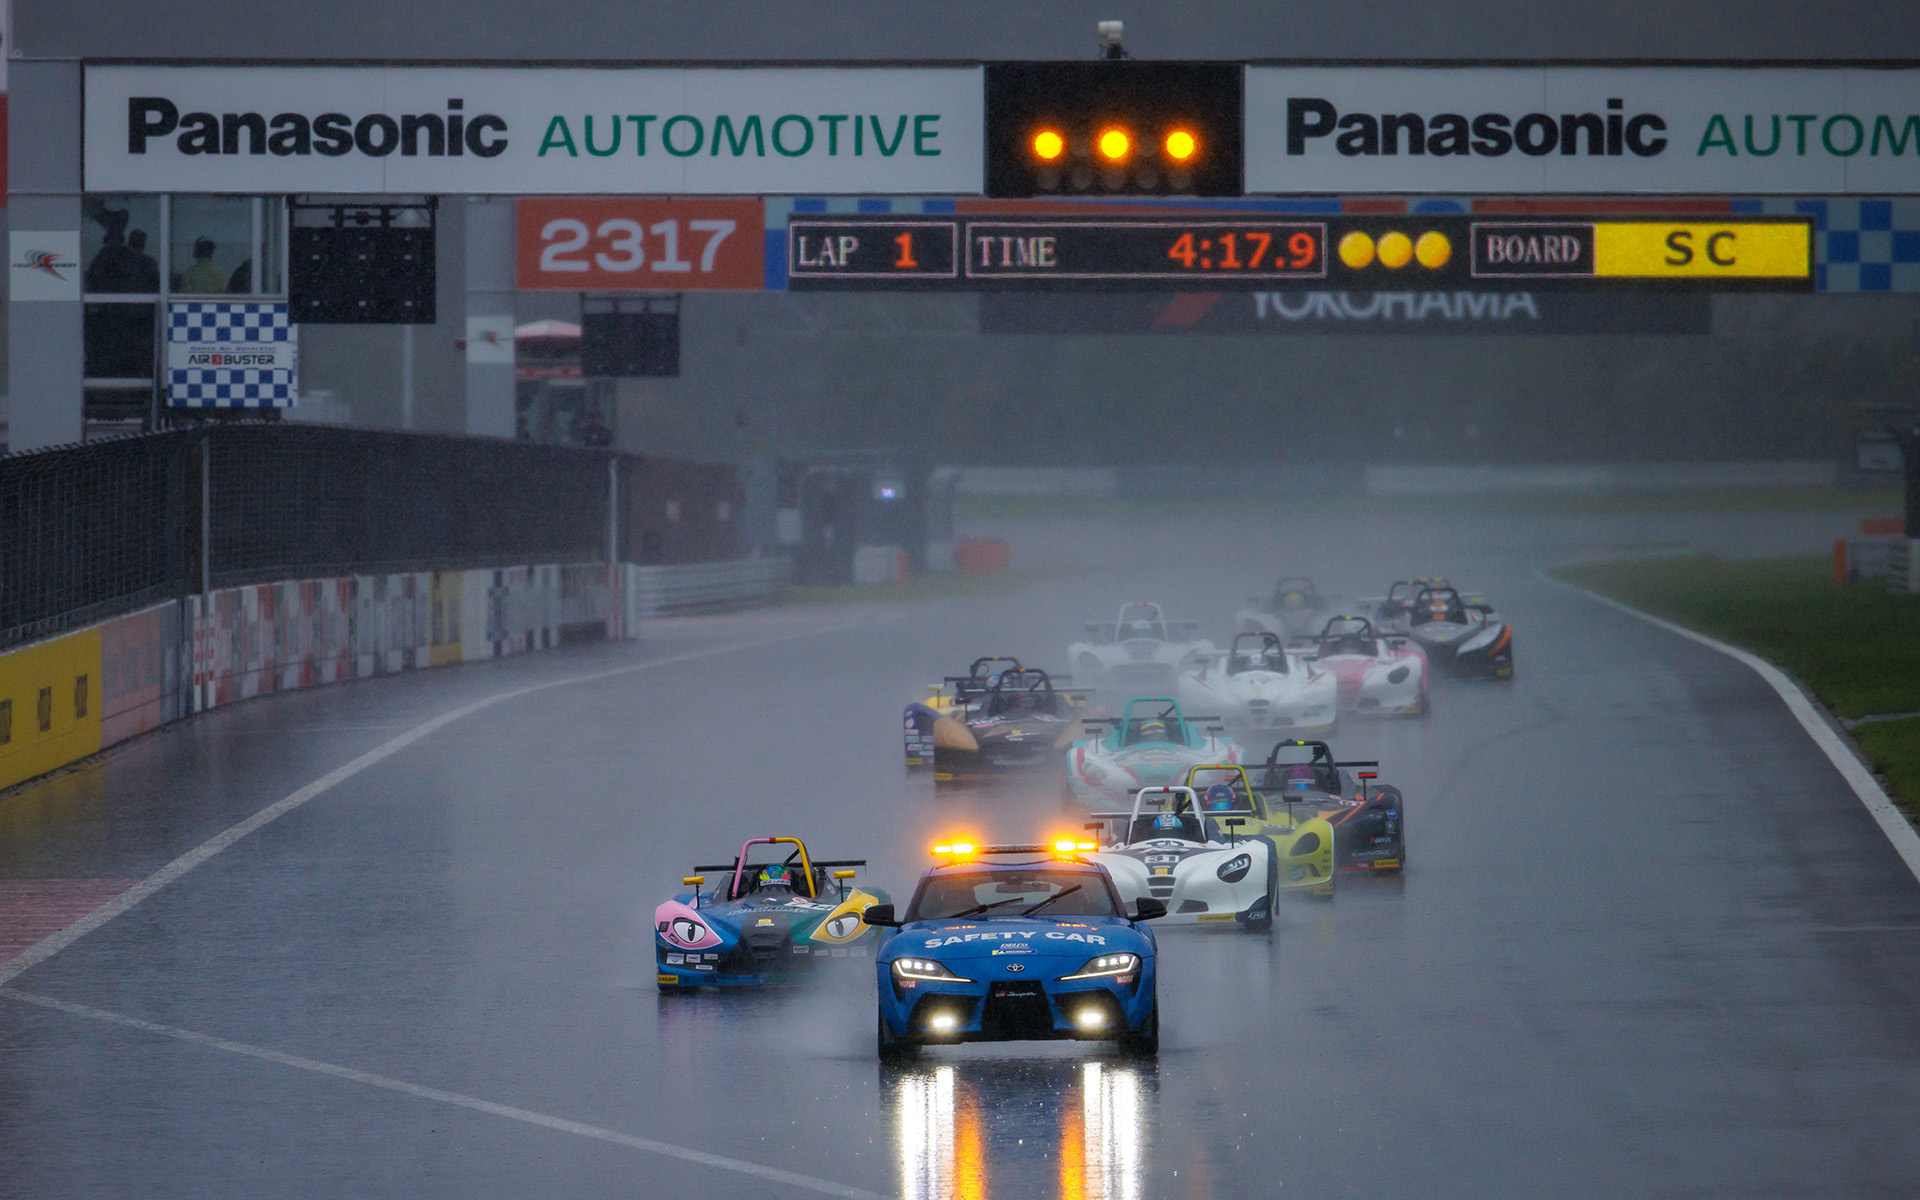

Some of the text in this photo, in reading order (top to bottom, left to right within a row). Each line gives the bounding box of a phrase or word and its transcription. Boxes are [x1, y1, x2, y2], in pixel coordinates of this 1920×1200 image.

[128, 97, 942, 157] Panasonic AUTOMOTIVE
[1286, 98, 1920, 157] Panasonic AUTOM
[540, 218, 736, 272] 2317
[799, 232, 917, 268] LAP 1
[976, 233, 1315, 269] TIME 4:17.9
[1487, 235, 1580, 264] BOARD
[188, 354, 275, 365] AIR BUSTER
[925, 931, 1106, 948] SAFETY CAR
